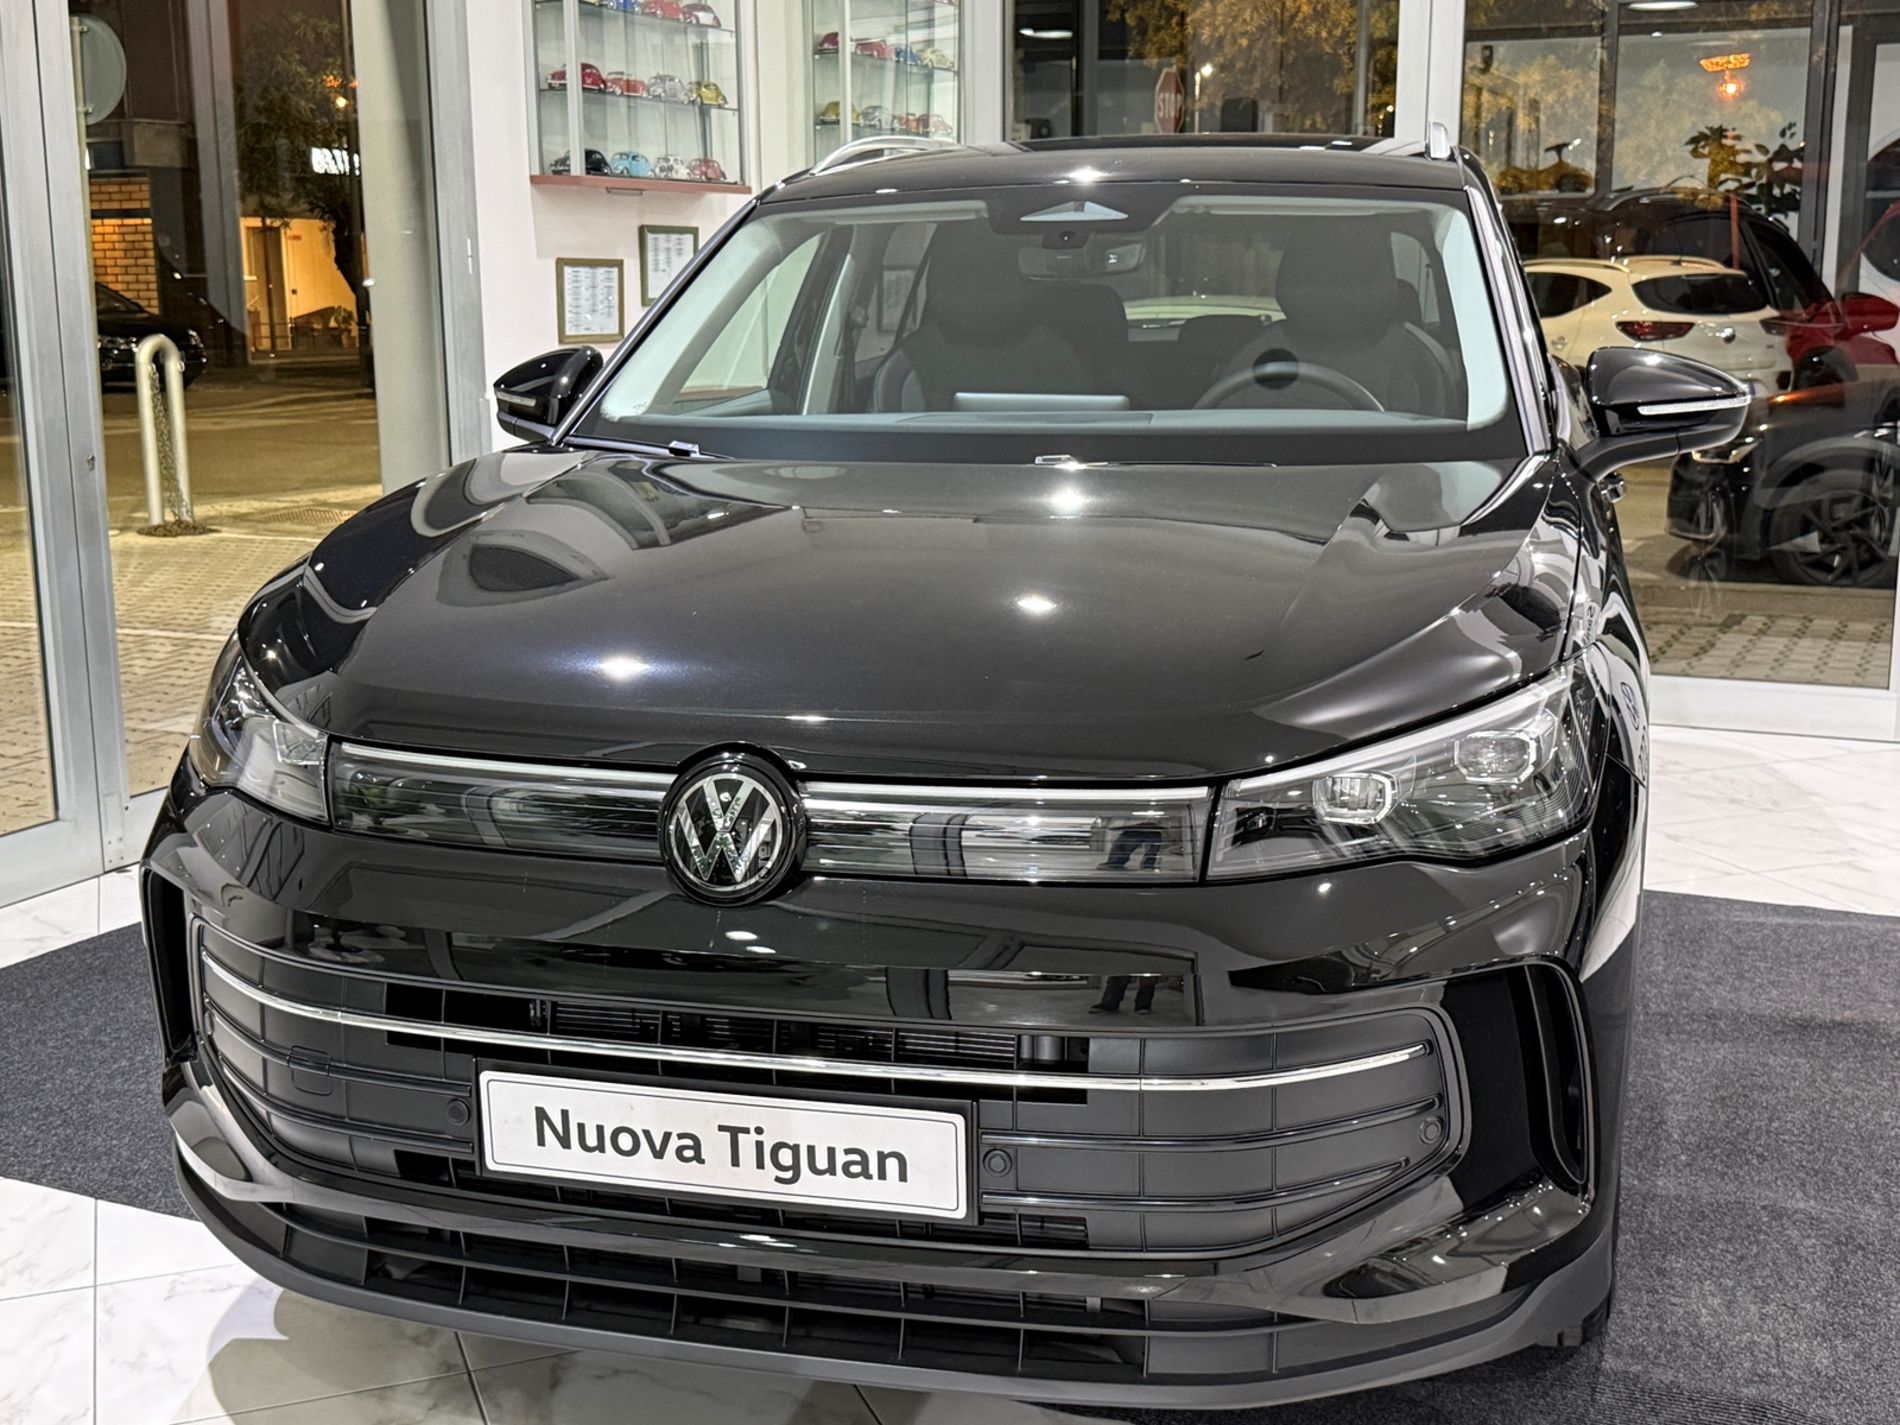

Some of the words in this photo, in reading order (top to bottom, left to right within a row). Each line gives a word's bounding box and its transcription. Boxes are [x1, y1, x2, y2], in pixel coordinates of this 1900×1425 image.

[1158, 92, 1184, 119] STOP
[671, 773, 783, 892] VW
[533, 1105, 705, 1165] Nuova
[717, 1124, 909, 1185] Tiguan
